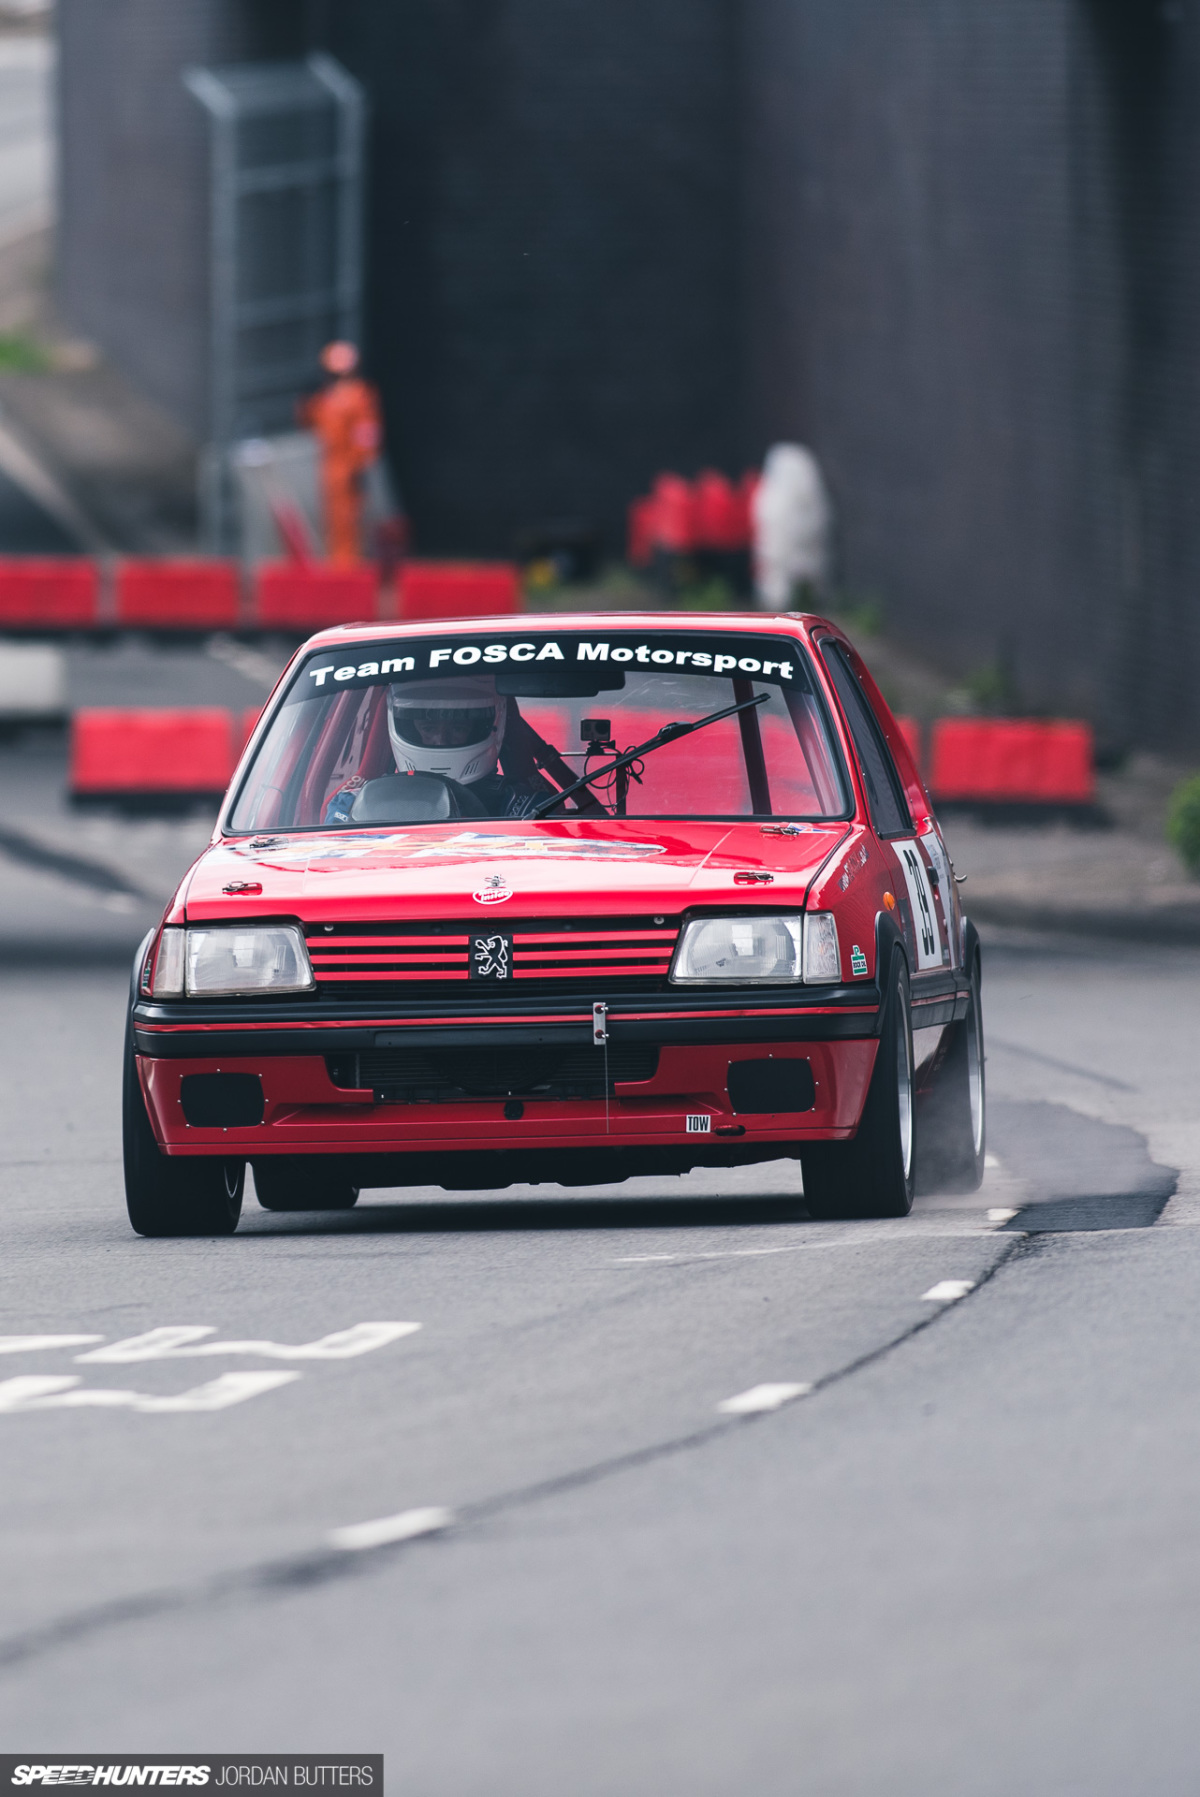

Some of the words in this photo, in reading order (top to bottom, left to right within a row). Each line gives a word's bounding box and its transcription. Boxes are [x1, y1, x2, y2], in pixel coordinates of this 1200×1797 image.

[309, 656, 415, 687] Team
[429, 642, 565, 668] FOSCA
[576, 642, 794, 680] Motorsport
[687, 1116, 709, 1132] TOW
